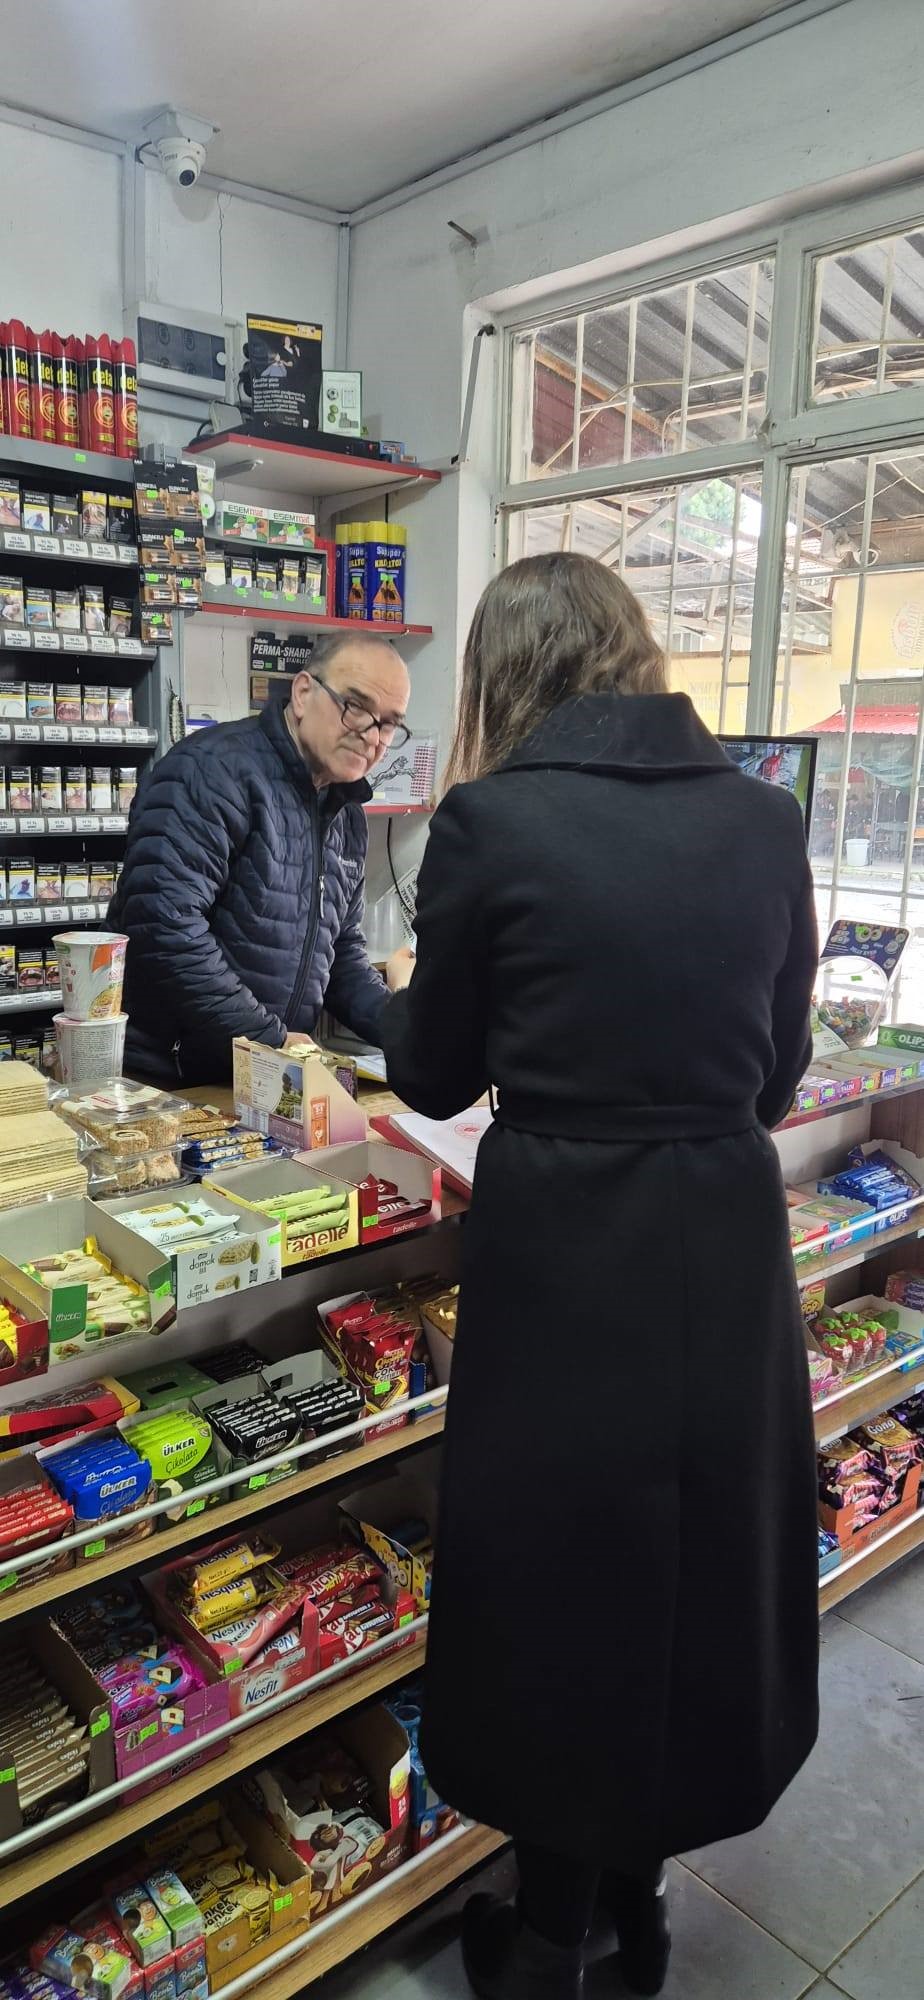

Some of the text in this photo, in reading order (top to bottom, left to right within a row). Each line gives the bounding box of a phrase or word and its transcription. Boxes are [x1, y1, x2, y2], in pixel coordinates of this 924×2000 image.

[92, 368, 113, 388] deta
[252, 643, 312, 659] PERMA-SHARP
[189, 1255, 216, 1271] damak
[866, 1418, 896, 1435] Gong
[163, 1437, 196, 1457] ÜLKER
[165, 1448, 199, 1476] Çikolata
[245, 1679, 278, 1705] Nesfit
